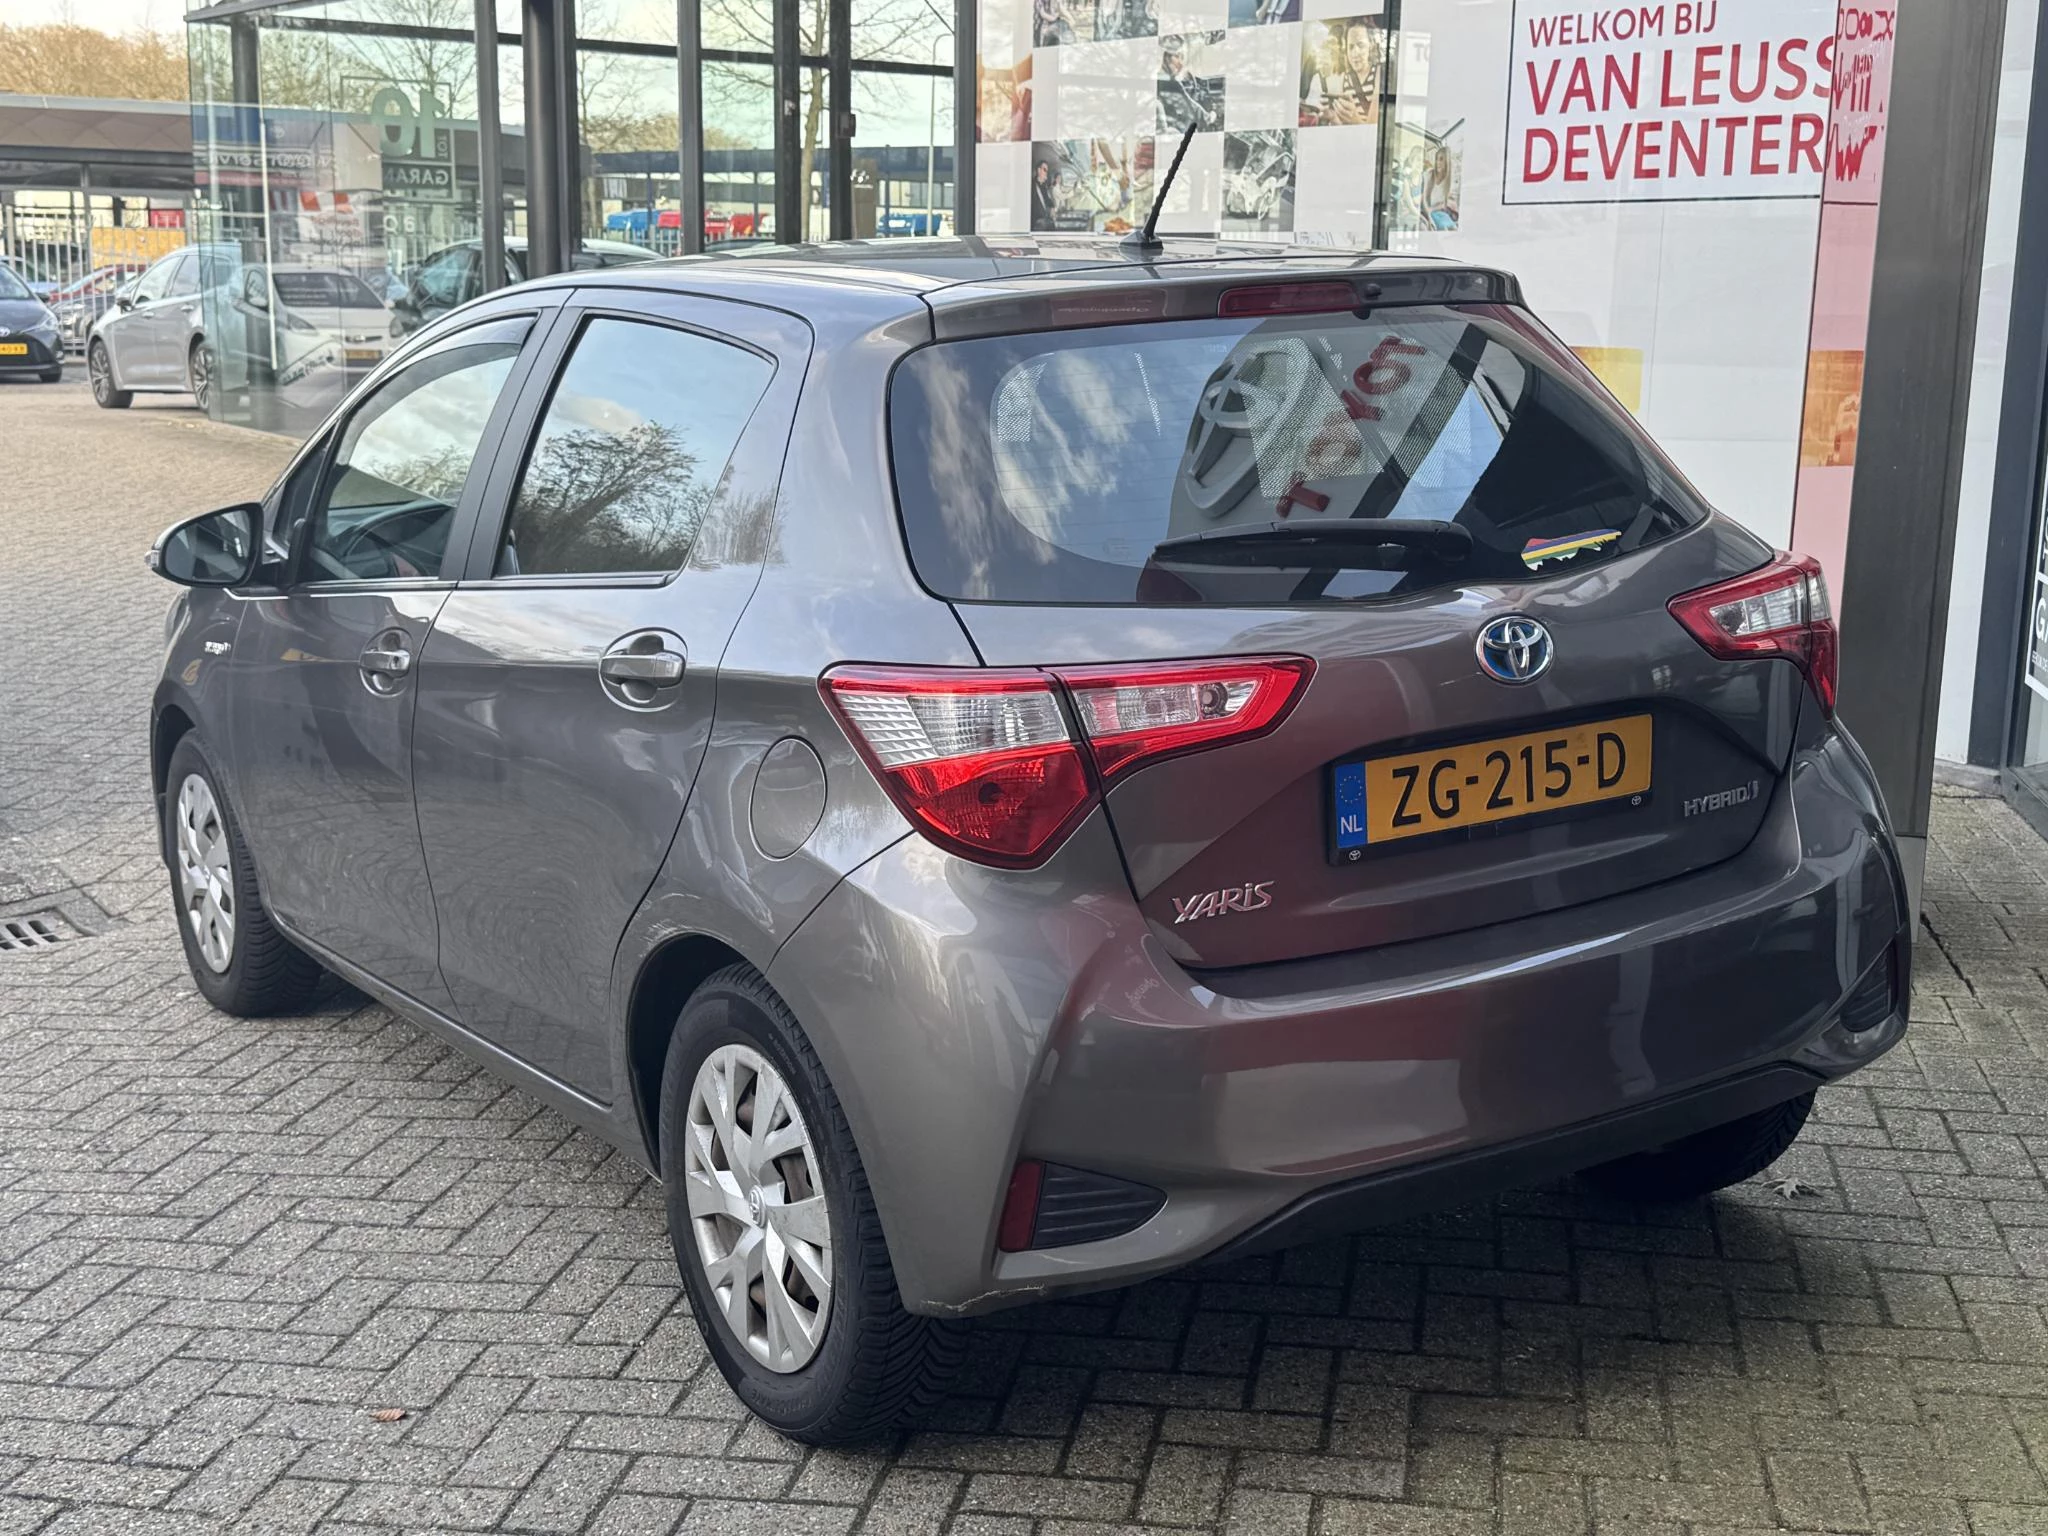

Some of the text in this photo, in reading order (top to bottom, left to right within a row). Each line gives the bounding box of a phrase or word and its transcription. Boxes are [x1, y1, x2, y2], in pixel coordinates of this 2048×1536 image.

[1529, 0, 1717, 48] WELKOM BIJ
[1526, 52, 1641, 116] VAN
[1523, 113, 1823, 183] DEVENTER
[1391, 732, 1626, 828] ZG-215-D
[1683, 785, 1748, 817] HYBRID
[1340, 815, 1363, 835] NL
